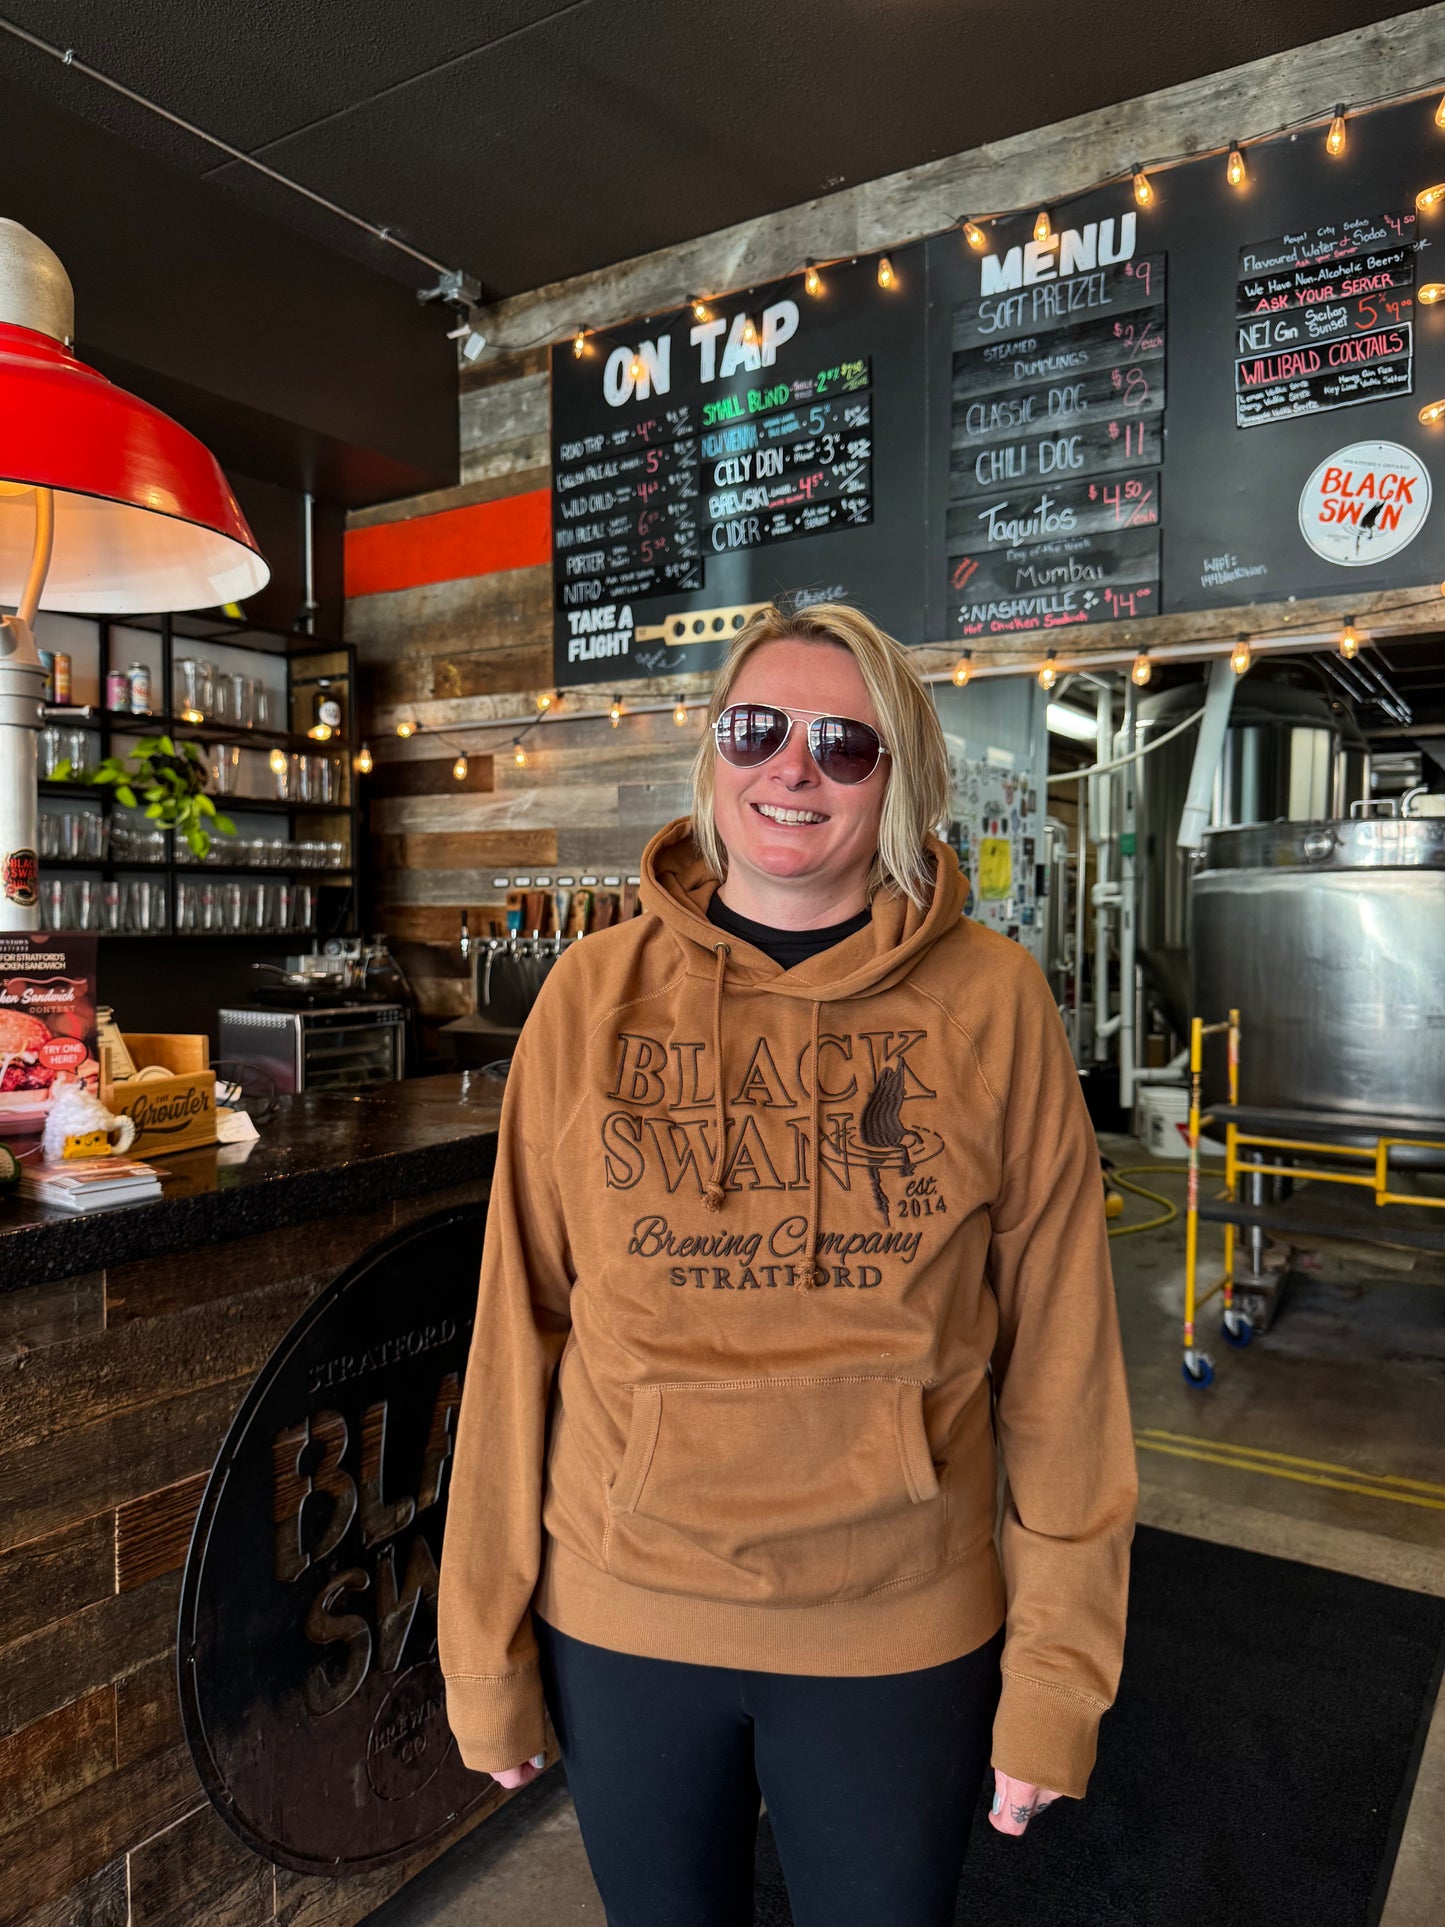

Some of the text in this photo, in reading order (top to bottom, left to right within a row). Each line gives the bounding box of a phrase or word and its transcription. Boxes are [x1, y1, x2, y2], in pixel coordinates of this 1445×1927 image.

[1243, 247, 1298, 272] Flavoured
[1301, 240, 1338, 258] Water
[1352, 227, 1387, 246] Sodas
[1283, 232, 1308, 246] Royal
[1317, 226, 1336, 238] City
[981, 212, 1136, 297] MENU
[1244, 251, 1405, 298] We Have Non-Alcoholic Beers!
[977, 292, 1030, 334] SOFT
[1032, 272, 1113, 322] PRETZEL
[1255, 272, 1394, 313] ASK YOUR SERVER
[1274, 321, 1299, 342] Gin
[1308, 316, 1349, 338] Sunset
[602, 334, 672, 408] ON
[690, 299, 800, 384] TAP
[983, 338, 1037, 362] STEAMED
[1014, 350, 1089, 381] DUMPLINGS
[1240, 332, 1404, 386] WILLIBALD COCKTAILS
[1324, 386, 1340, 396] Key
[703, 394, 746, 426] SMALL
[965, 395, 1037, 437] CLASSIC
[1047, 383, 1088, 418] DOG
[755, 446, 784, 479] DEN
[975, 444, 1027, 486] CHILI
[1038, 435, 1085, 475] DOG
[709, 485, 769, 518] BREWSKI
[1320, 467, 1418, 504] BLACK
[561, 497, 587, 519] WILD
[588, 491, 613, 514] CHILD
[978, 494, 1078, 548] Taquitos
[1318, 498, 1404, 531] SWN
[712, 515, 762, 552] CIDER
[566, 550, 606, 576] PORTER
[1015, 555, 1104, 589] Mumbai
[563, 579, 603, 605] NITRO
[970, 589, 1078, 623] NASHVILLE
[568, 604, 633, 635] TAKE A
[990, 616, 1041, 633] Chicken
[568, 630, 632, 663] FLIGHT
[1, 953, 16, 962] FOR
[25, 961, 66, 971] SANDWICH
[21, 987, 75, 1005] Sandwich
[29, 1005, 76, 1014] CONTEST
[43, 1043, 82, 1055] TRY ONE
[50, 1054, 77, 1064] HERE!
[606, 1030, 937, 1112] BLACK
[156, 1094, 169, 1103] THE
[122, 1087, 209, 1144] Growler
[601, 1110, 854, 1194] SWAN
[905, 1176, 938, 1198] est.
[898, 1198, 947, 1220] 2014
[629, 1215, 923, 1267] Brewing Cmpany
[306, 1319, 456, 1394] STRATFORD
